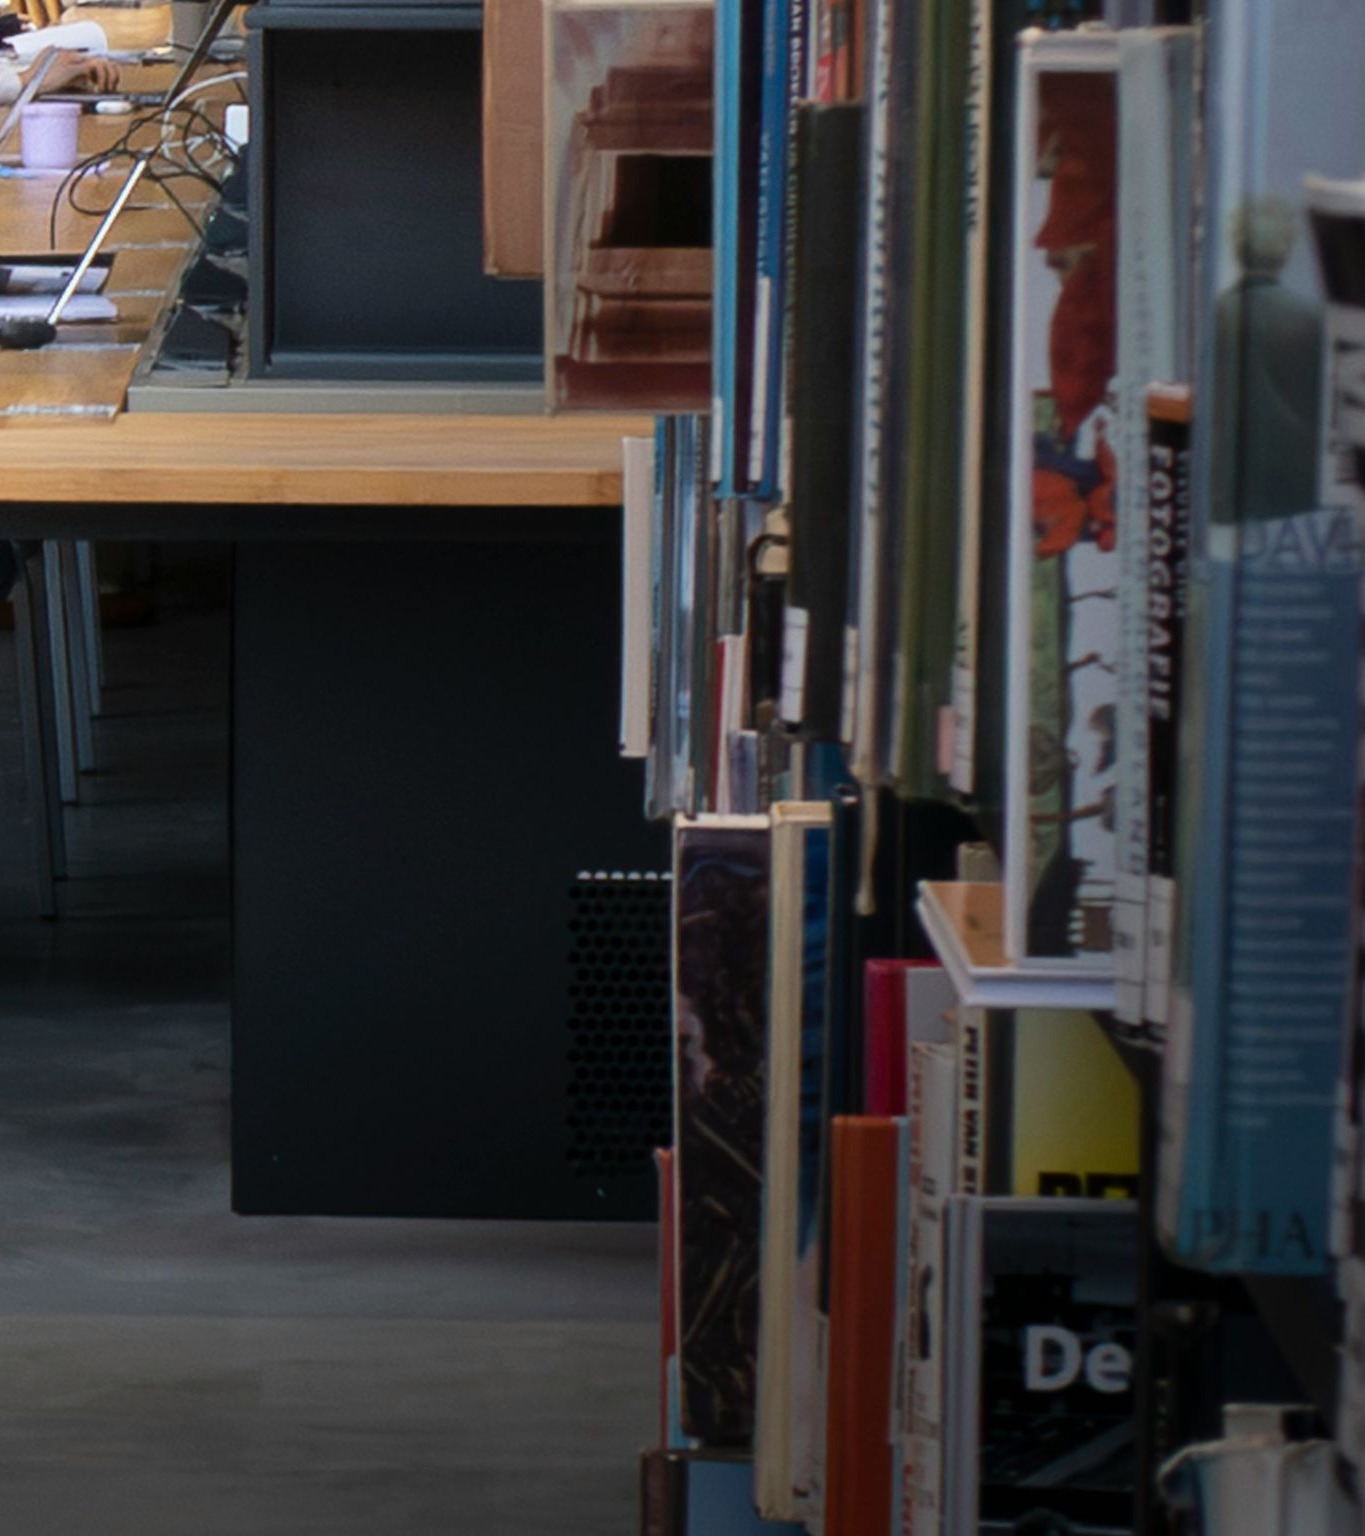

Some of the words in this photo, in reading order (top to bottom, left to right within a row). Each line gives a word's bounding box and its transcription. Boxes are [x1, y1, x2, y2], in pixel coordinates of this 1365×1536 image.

[1150, 444, 1173, 720] FOTOGRAFIE
[964, 1108, 979, 1158] VAN
[1023, 1324, 1133, 1394] De
